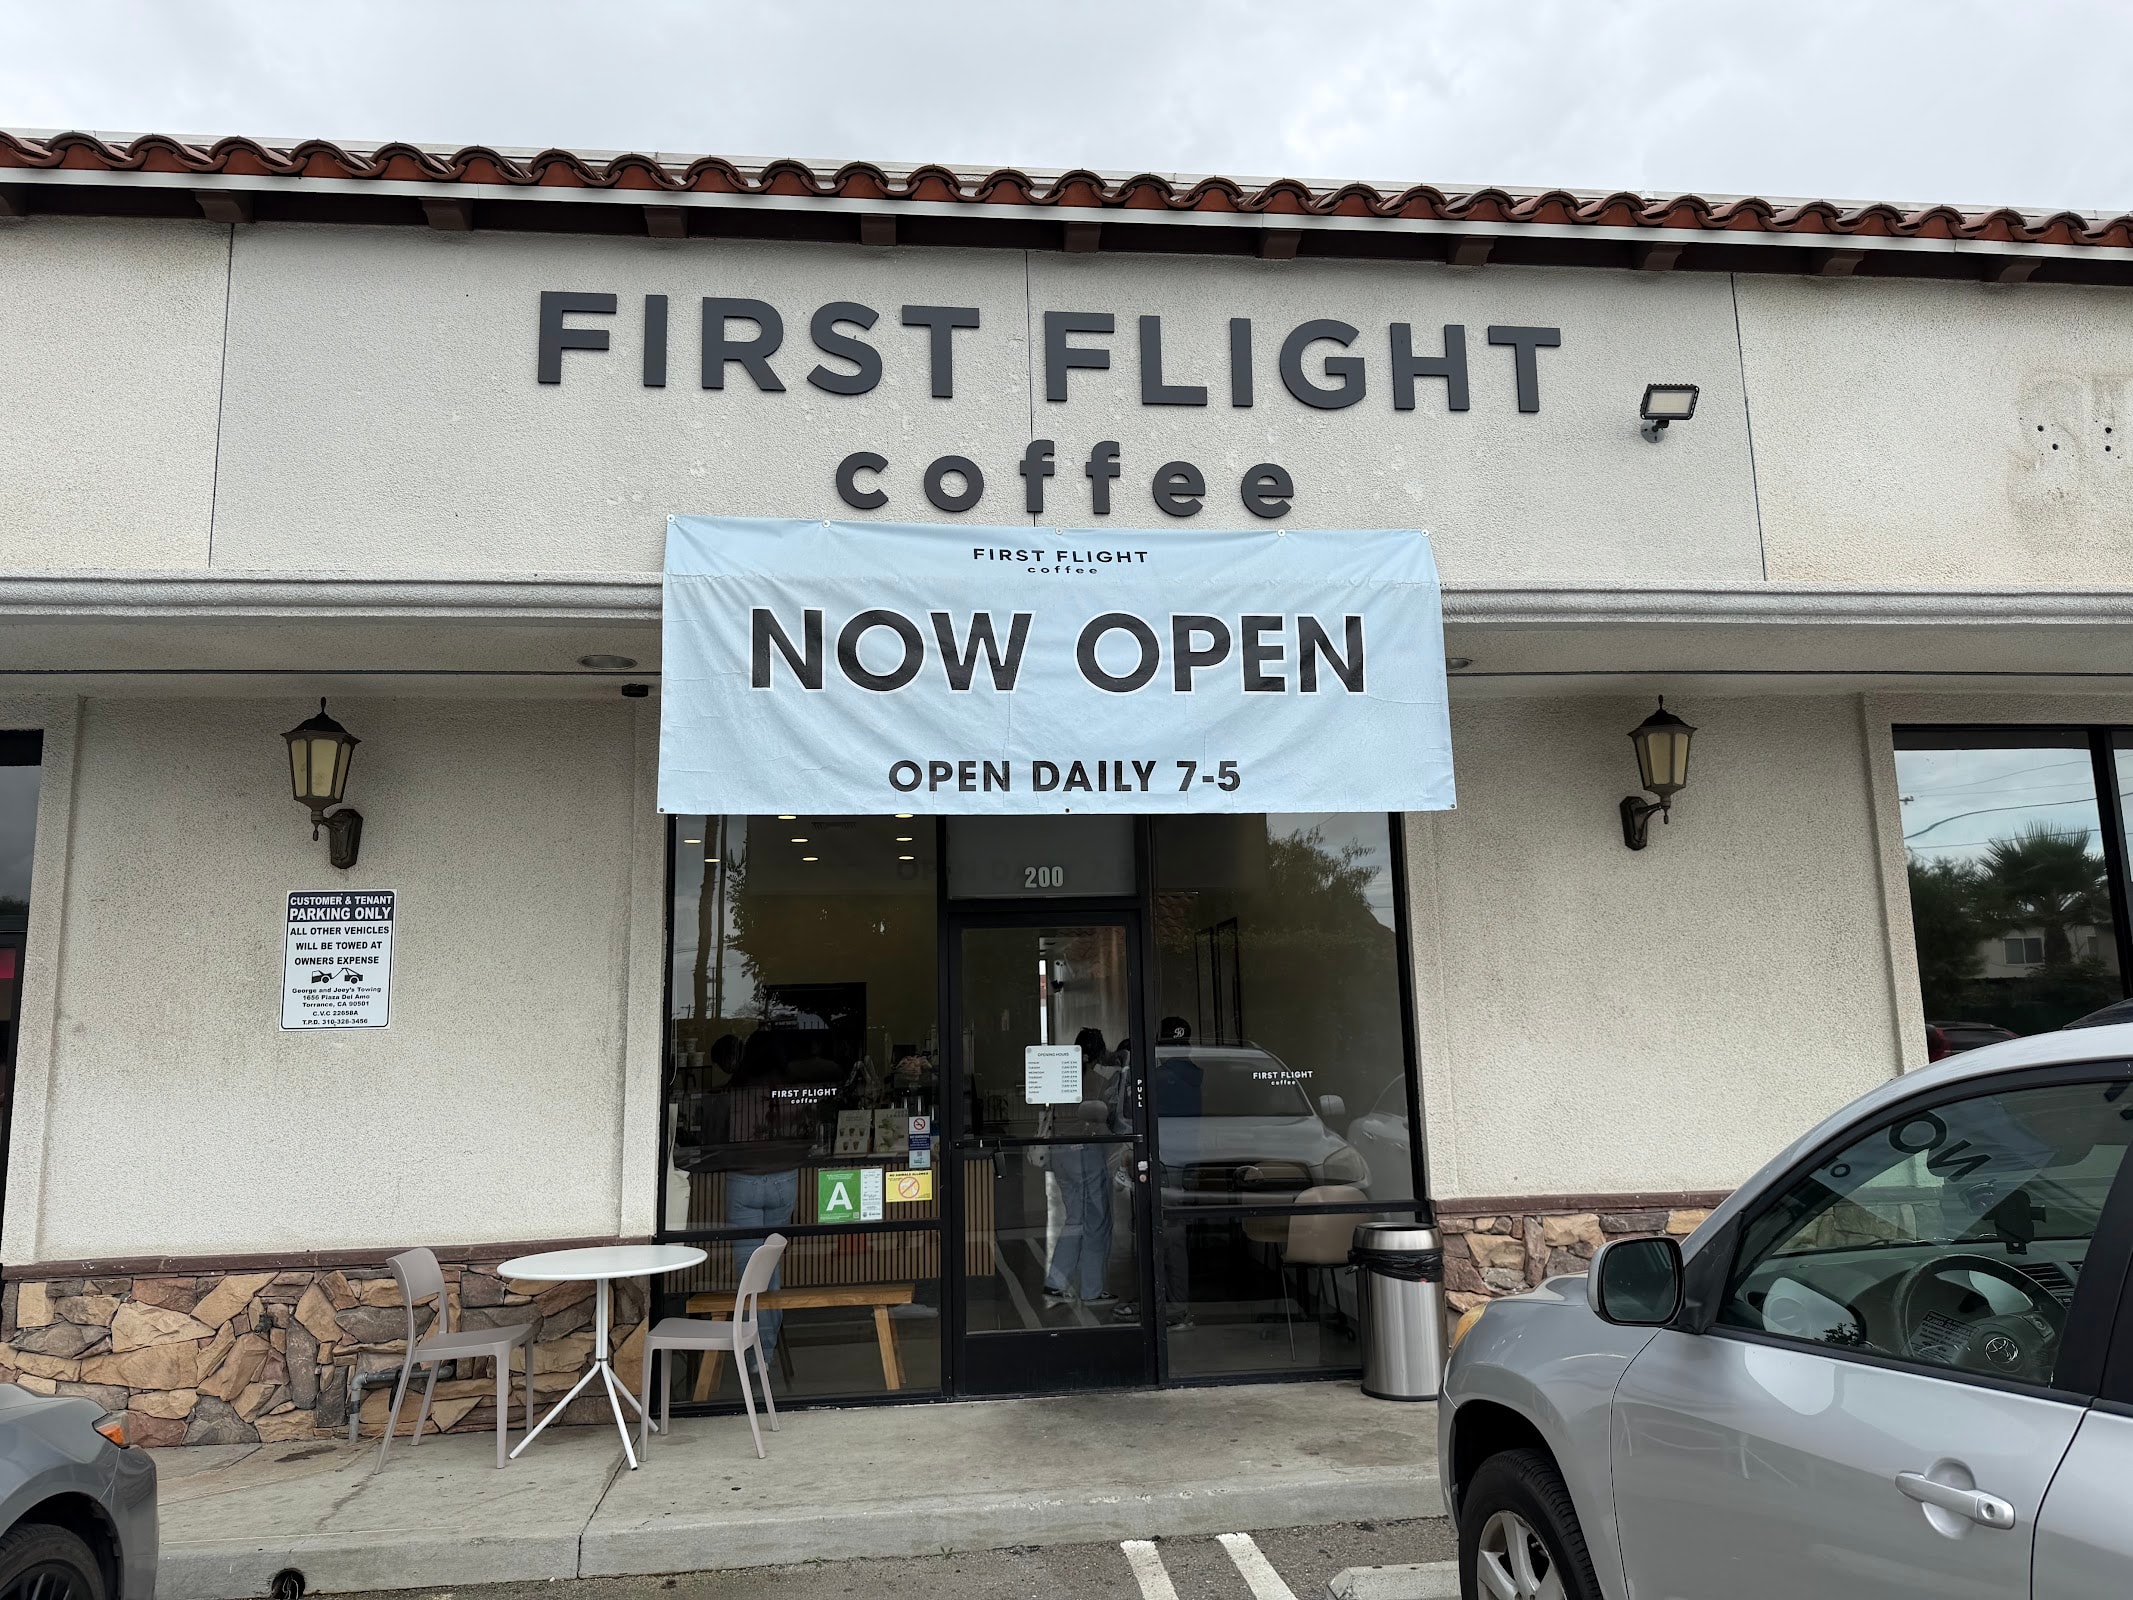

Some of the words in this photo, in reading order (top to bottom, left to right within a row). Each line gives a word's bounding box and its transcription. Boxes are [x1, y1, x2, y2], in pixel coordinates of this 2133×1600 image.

[538, 291, 980, 398] FIRST
[1045, 311, 1561, 413] FLIGHT
[835, 439, 1294, 519] coffee
[973, 548, 1045, 562] FIRST
[1056, 550, 1148, 563] FLIGHT
[1027, 565, 1098, 575] coffee
[751, 607, 1034, 694] NOW
[1076, 612, 1366, 695] OPEN
[888, 759, 1011, 793] OPEN
[1031, 760, 1157, 793] DAILY
[1176, 760, 1241, 793] 7-5
[1024, 866, 1064, 888] 200
[290, 896, 343, 906] CUSTOMER
[344, 895, 352, 905] &
[354, 895, 393, 905] TENANT
[289, 907, 351, 921] PARKING
[354, 906, 392, 920] ONLY
[290, 927, 307, 936] ALL
[310, 927, 342, 935] OTHER
[344, 926, 390, 935] VEHICLES
[296, 942, 318, 951] WILL
[320, 942, 333, 950] BE
[336, 941, 368, 950] TOWED
[370, 941, 383, 949] AT
[294, 956, 334, 966] OWNERS
[337, 956, 379, 965] EXPENSE
[1252, 1071, 1278, 1080] FIRST
[1280, 1070, 1313, 1079] FLIGHT
[771, 1089, 800, 1099] FIRST
[802, 1087, 838, 1097] FLIGHT
[826, 1181, 854, 1212] A
